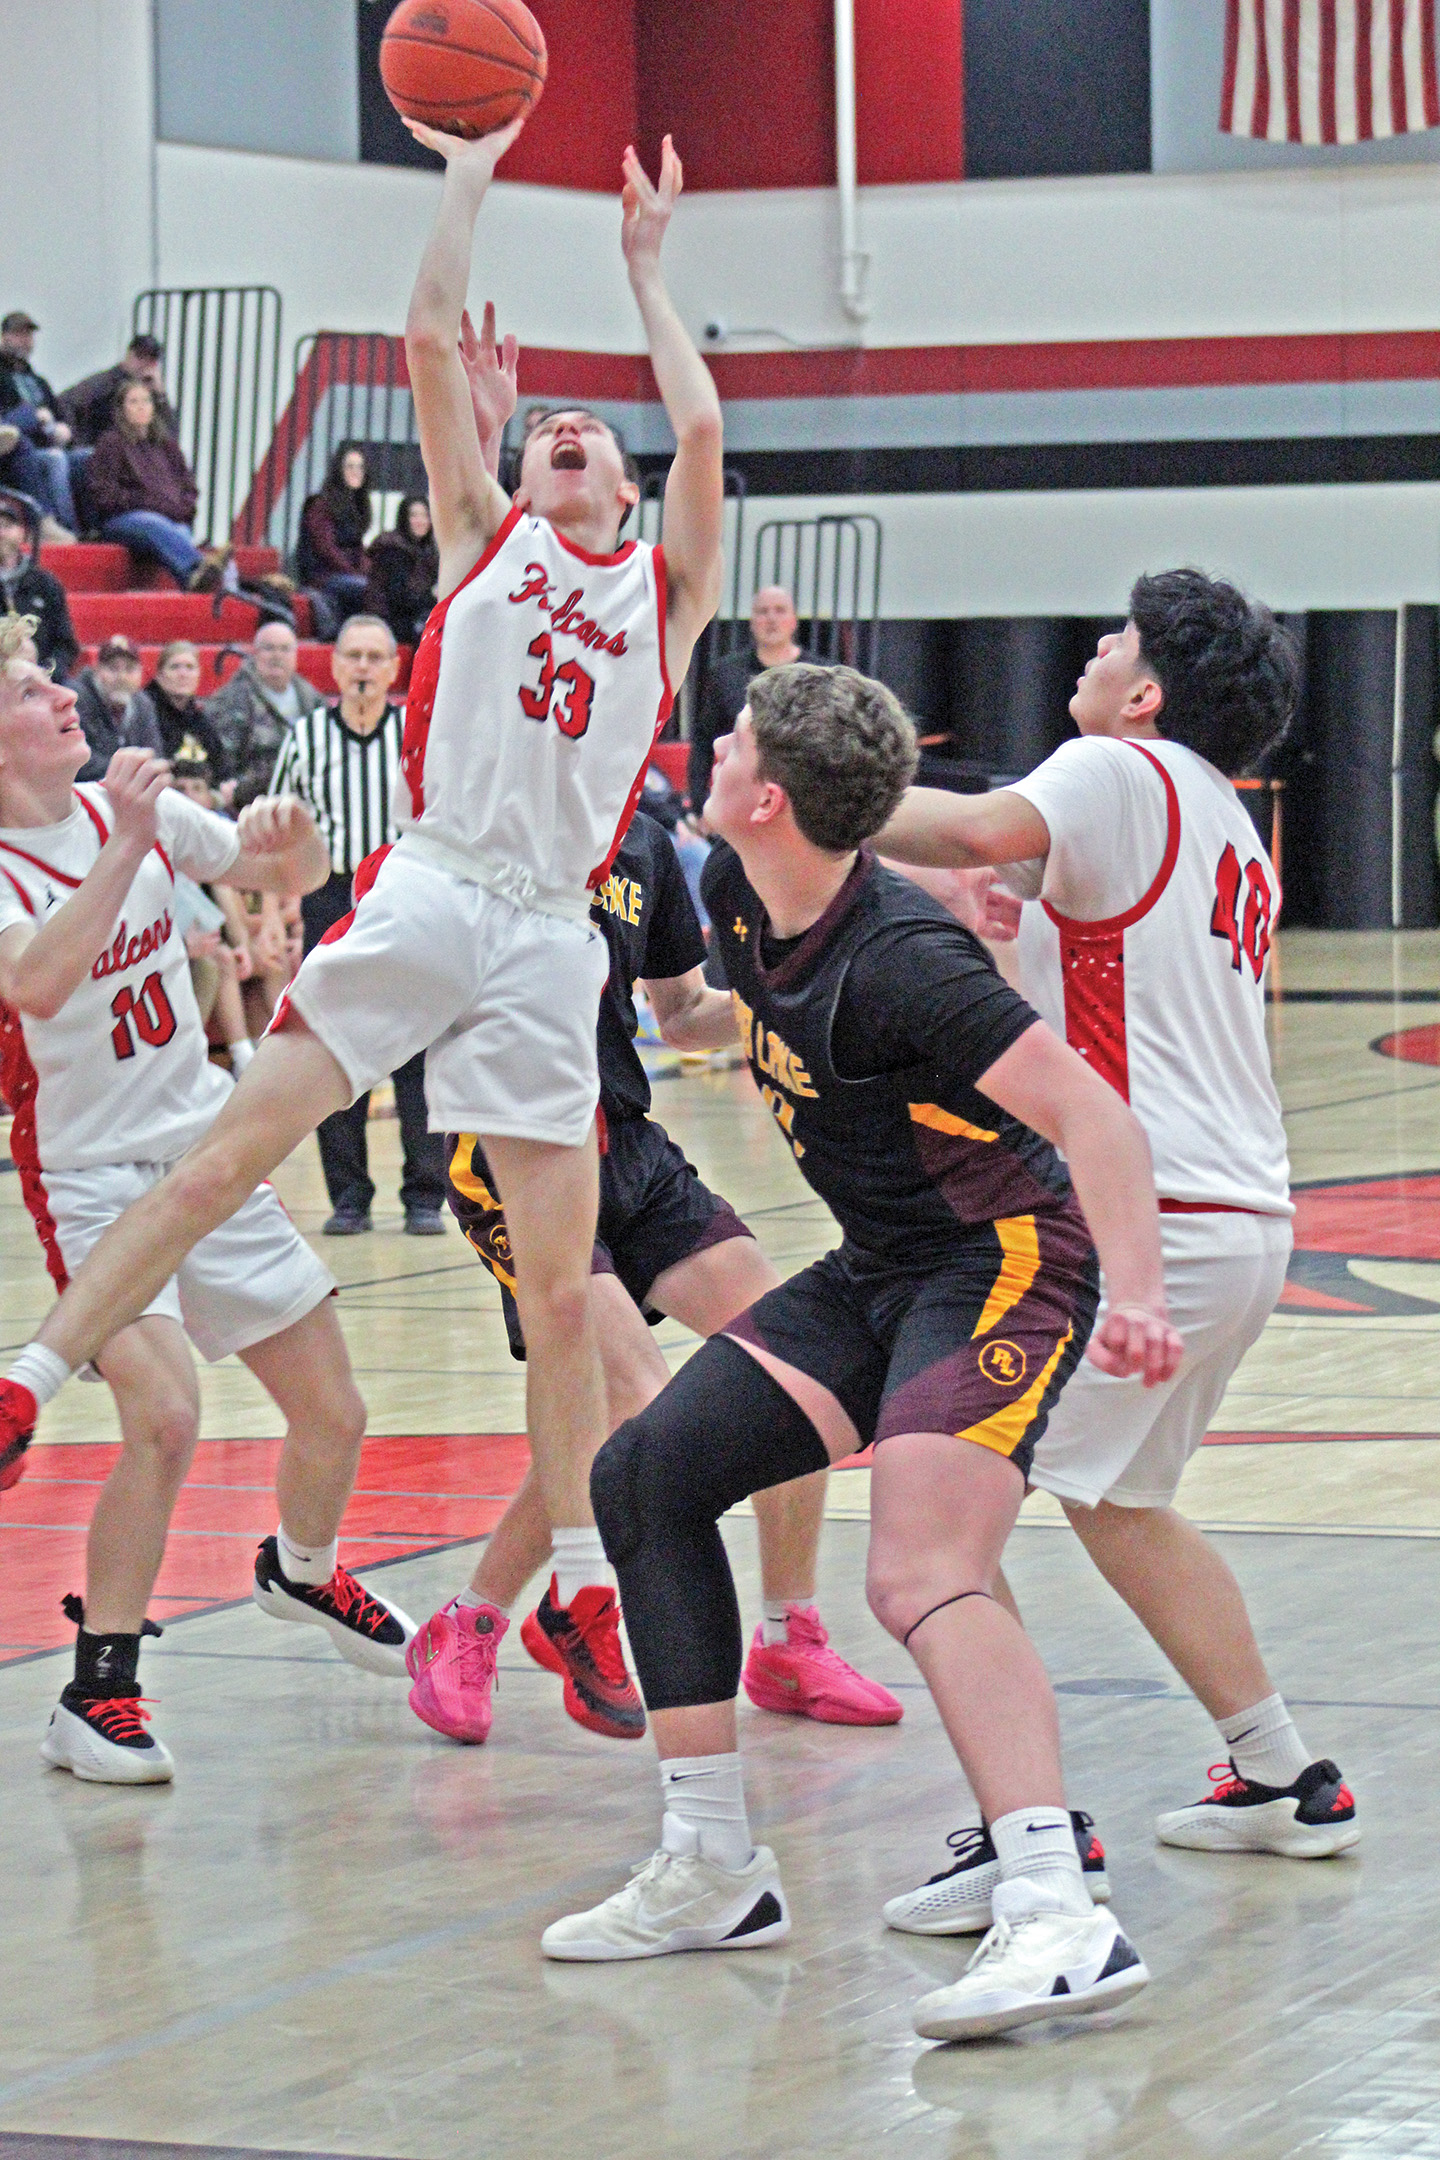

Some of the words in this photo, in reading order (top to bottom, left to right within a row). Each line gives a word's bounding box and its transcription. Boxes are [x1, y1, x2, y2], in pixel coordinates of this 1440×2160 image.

[518, 631, 595, 739] 33
[592, 873, 643, 927] AKE
[110, 970, 178, 1061] 10
